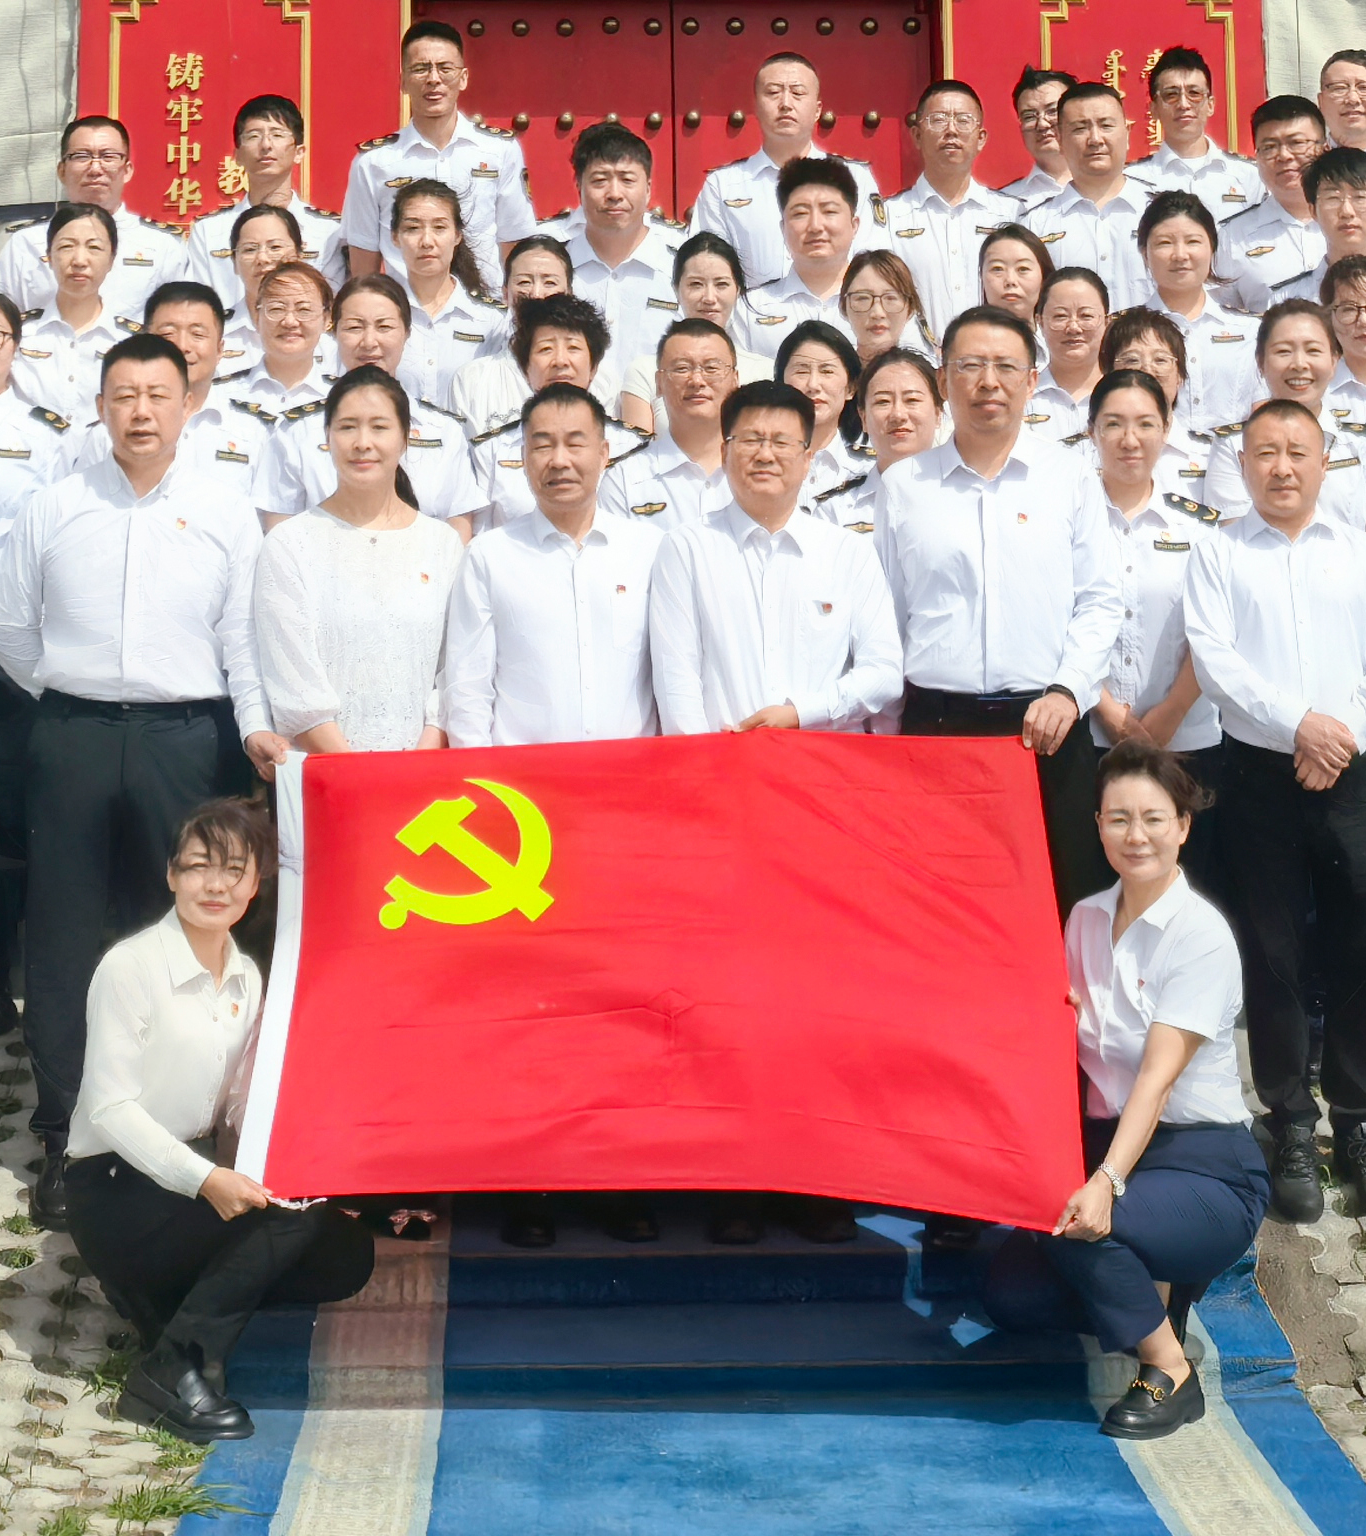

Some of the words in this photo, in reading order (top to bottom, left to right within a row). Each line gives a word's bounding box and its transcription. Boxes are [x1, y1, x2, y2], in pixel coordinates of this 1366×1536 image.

[164, 52, 205, 238] 铸牢中华
[217, 156, 249, 207] 教
